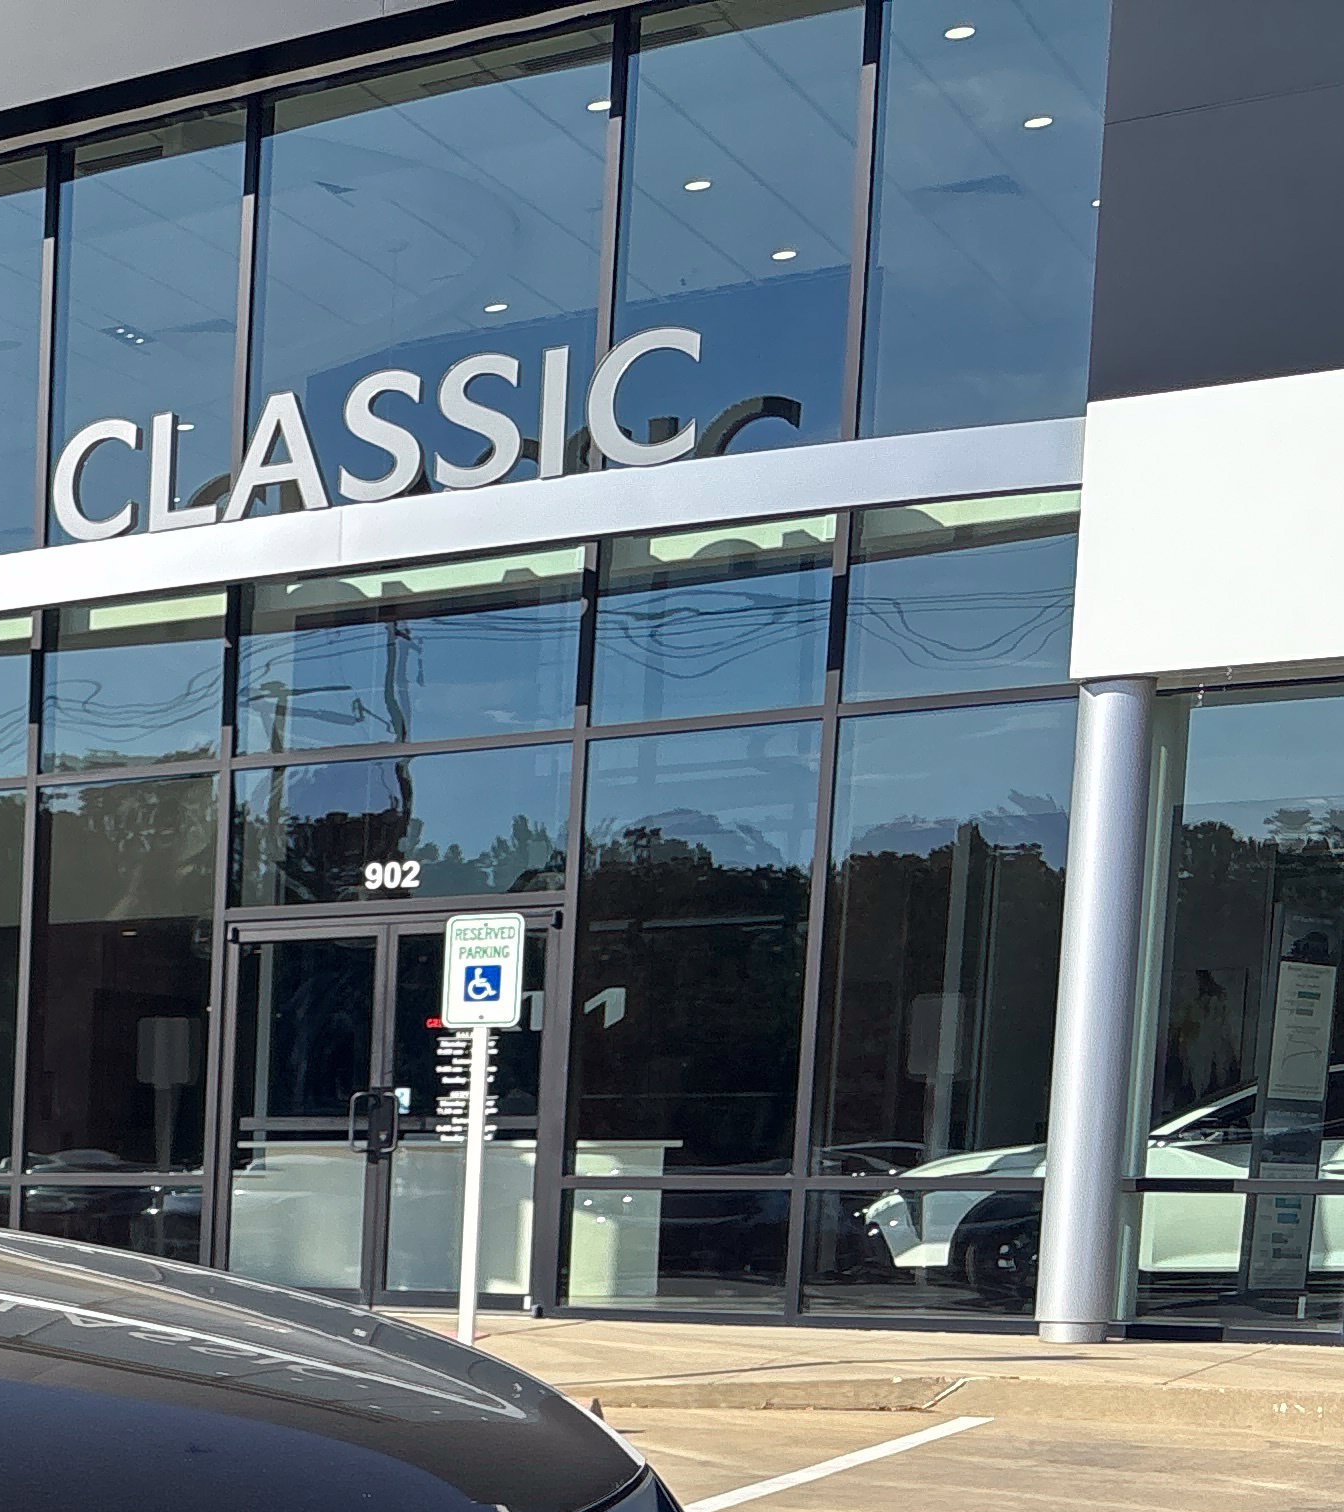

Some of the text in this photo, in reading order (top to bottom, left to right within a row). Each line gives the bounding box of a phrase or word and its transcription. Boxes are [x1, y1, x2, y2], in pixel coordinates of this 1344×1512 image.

[52, 325, 703, 541] CLASSIC
[364, 860, 421, 890] 902
[454, 926, 516, 941] RESERVED
[458, 945, 510, 960] PARKING
